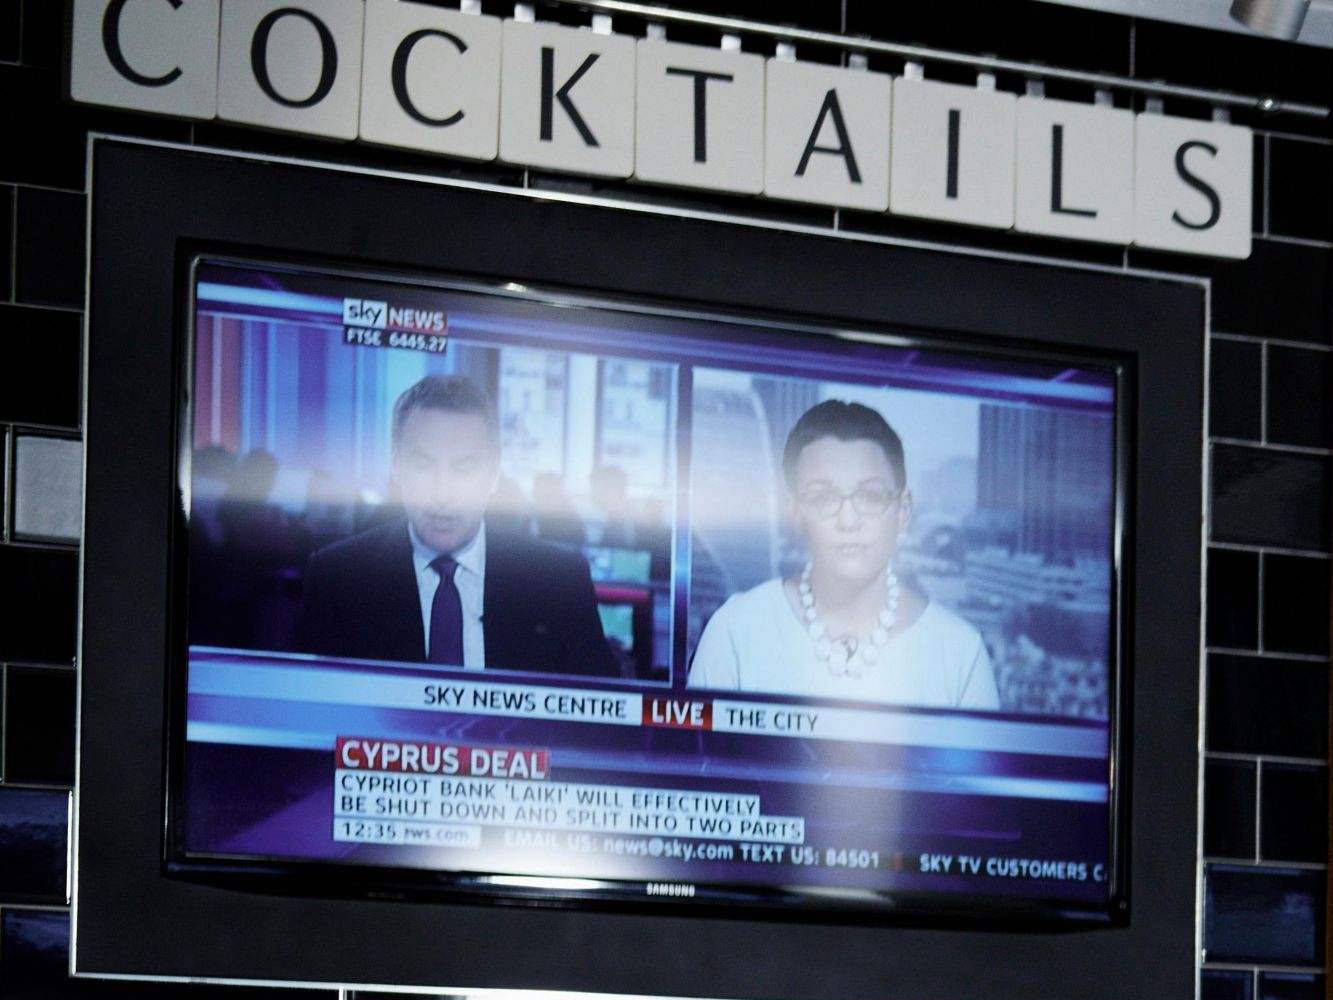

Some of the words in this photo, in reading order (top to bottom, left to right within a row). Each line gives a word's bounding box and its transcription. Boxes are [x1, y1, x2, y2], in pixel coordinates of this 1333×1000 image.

[102, 0, 1221, 230] COCKTAILS
[348, 299, 382, 326] sky
[389, 307, 444, 332] NEWS
[347, 328, 381, 346] FTSE
[424, 685, 465, 706] SKY
[473, 690, 536, 712] NEWS
[544, 694, 627, 718] CENTRE
[652, 699, 704, 726] LIVE
[726, 707, 767, 729] THE
[774, 711, 818, 732] CITY
[342, 740, 460, 774] CYPRUS
[471, 748, 546, 779] DEAL
[341, 773, 431, 795] CYPRIOT
[441, 781, 495, 799] BANK
[505, 783, 568, 804] 'LAIKI'
[576, 789, 623, 808] WILL
[632, 792, 756, 816] EFFECTIVELY
[341, 795, 367, 813] BE
[376, 797, 430, 816] SHUT
[441, 802, 505, 821] DOWN
[515, 806, 557, 823] AND
[566, 809, 621, 828] SPLIT
[629, 813, 677, 832] INTO
[685, 816, 731, 835] TWO
[740, 820, 801, 839] PARTS
[342, 822, 396, 840] 12:35
[504, 829, 560, 849] EMAIL
[567, 832, 597, 852] US:
[603, 837, 734, 862] news@sky.com
[740, 843, 785, 863] TEXT
[791, 846, 819, 866] US:
[825, 848, 880, 868] 84501
[920, 853, 952, 872] SKY
[958, 855, 981, 874] TV
[986, 857, 1087, 881] CUSTOMERS
[646, 883, 695, 897] SAMSUNG
